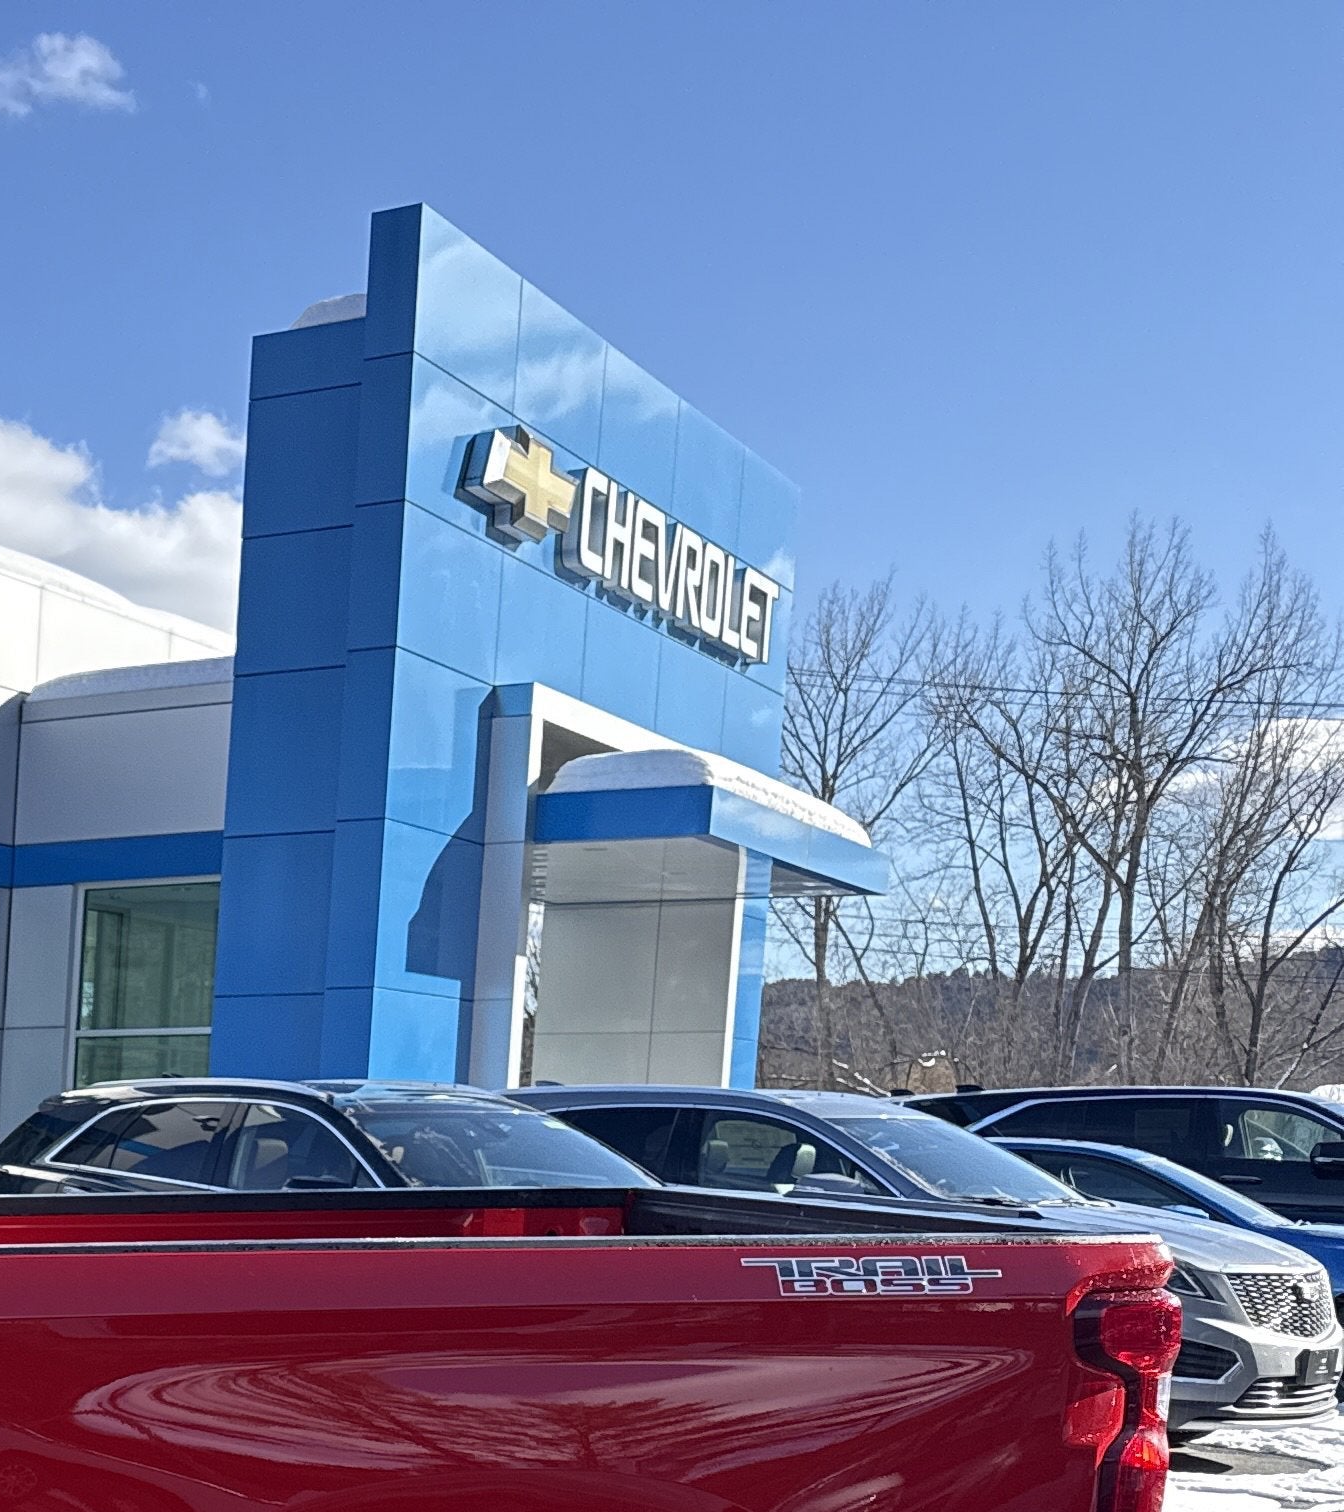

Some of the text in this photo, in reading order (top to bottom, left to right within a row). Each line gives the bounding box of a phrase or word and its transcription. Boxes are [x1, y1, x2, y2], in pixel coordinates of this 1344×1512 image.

[574, 466, 780, 665] CHEVROLET
[740, 1256, 1003, 1279] TRAIL
[779, 1276, 974, 1297] BOSS
